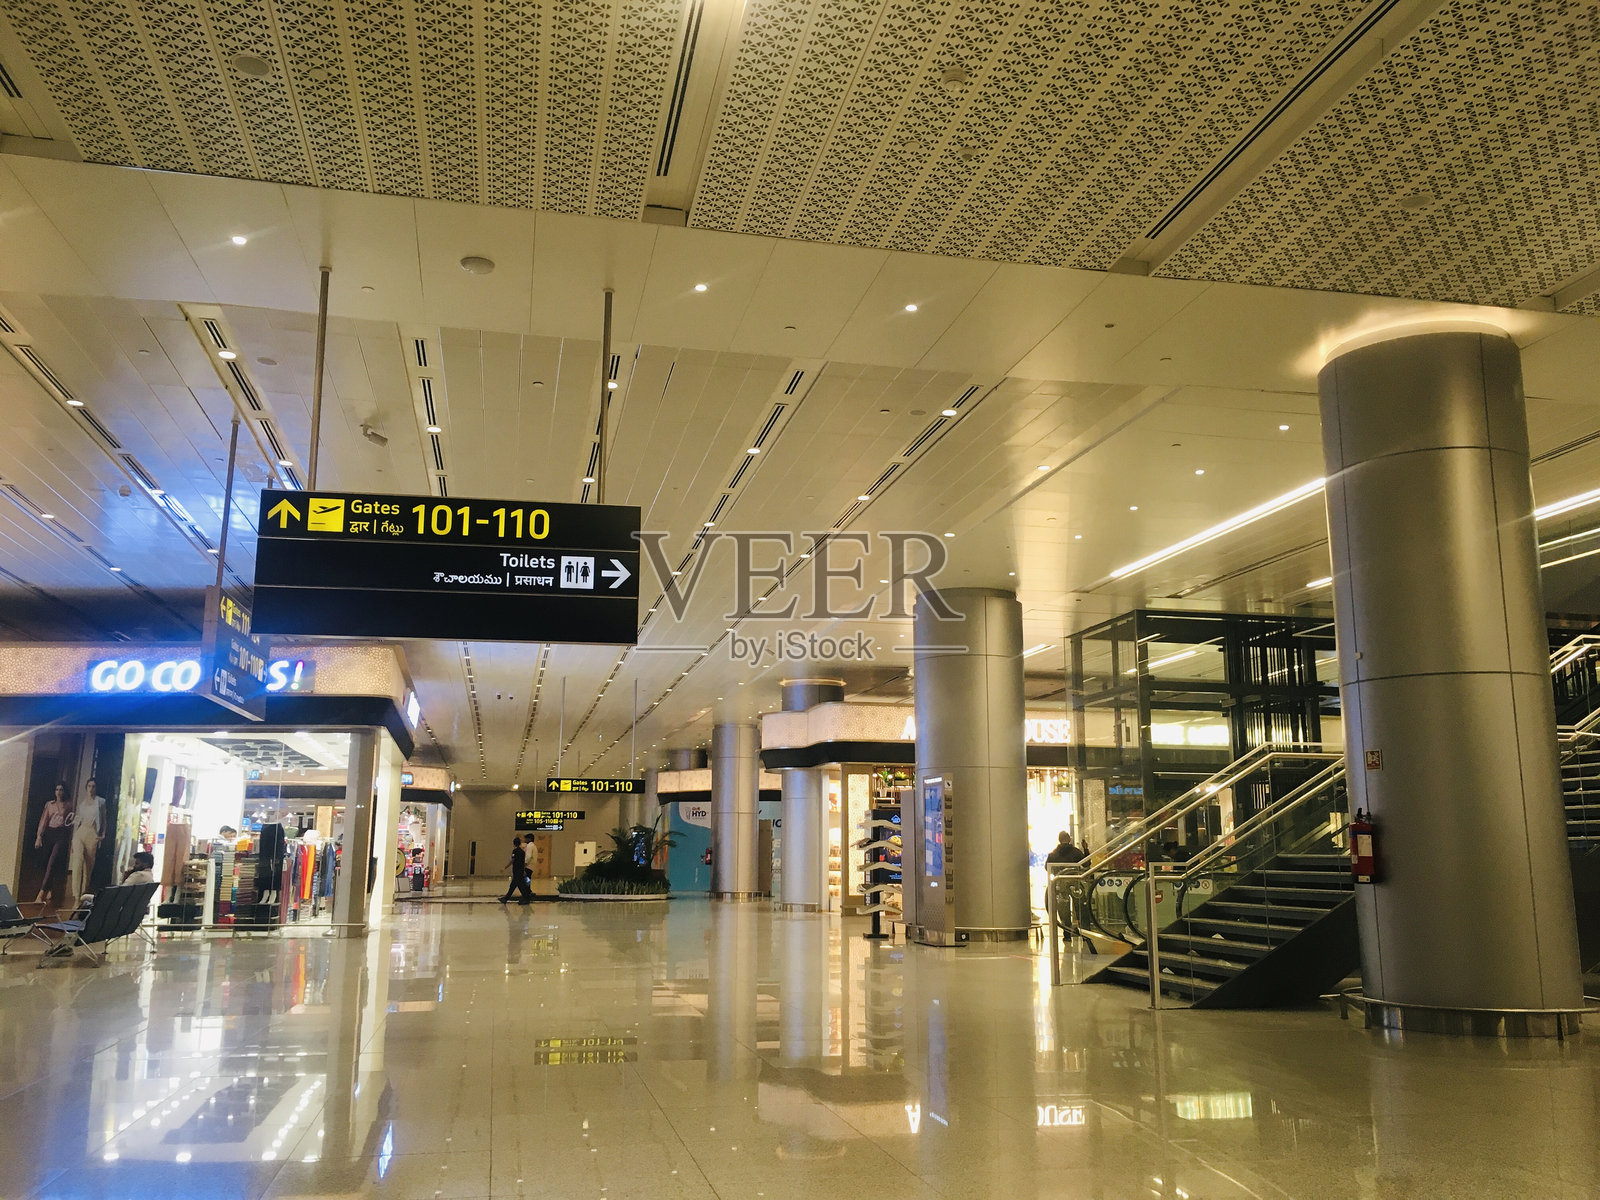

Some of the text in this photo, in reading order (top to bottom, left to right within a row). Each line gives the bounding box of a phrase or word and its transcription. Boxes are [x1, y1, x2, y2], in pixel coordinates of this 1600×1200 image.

[350, 499, 400, 515] Gates
[412, 504, 550, 540] 101-110
[499, 553, 556, 569] Toilets
[91, 660, 145, 691] GO
[591, 780, 633, 792] 101-110
[552, 811, 578, 819] 101-110
